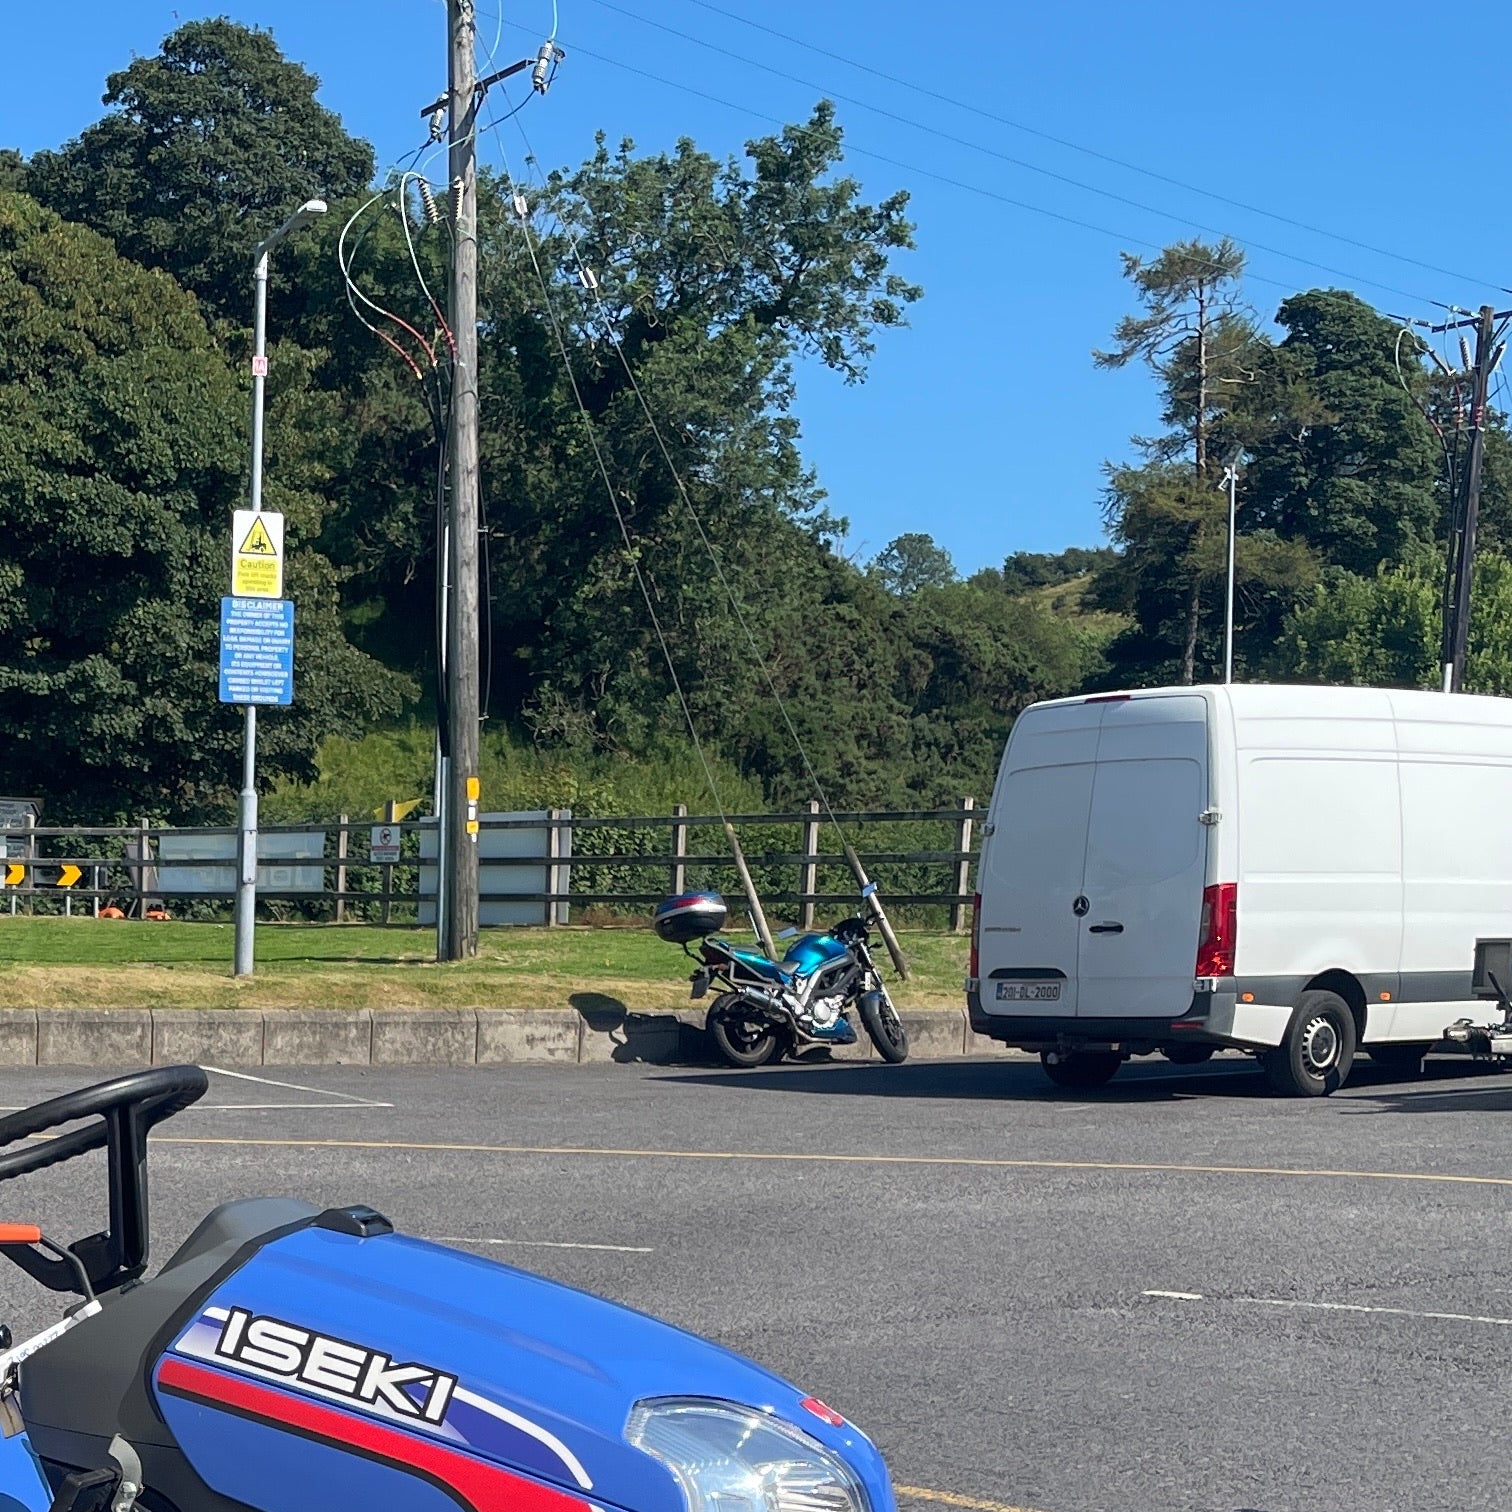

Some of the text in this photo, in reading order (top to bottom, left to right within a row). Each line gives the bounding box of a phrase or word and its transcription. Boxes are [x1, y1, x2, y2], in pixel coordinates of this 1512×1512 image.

[240, 560, 275, 569] Caution
[232, 600, 283, 611] DISCLAIMER
[1003, 986, 1058, 998] 201-DL-2000
[215, 1305, 458, 1427] ISEKI
